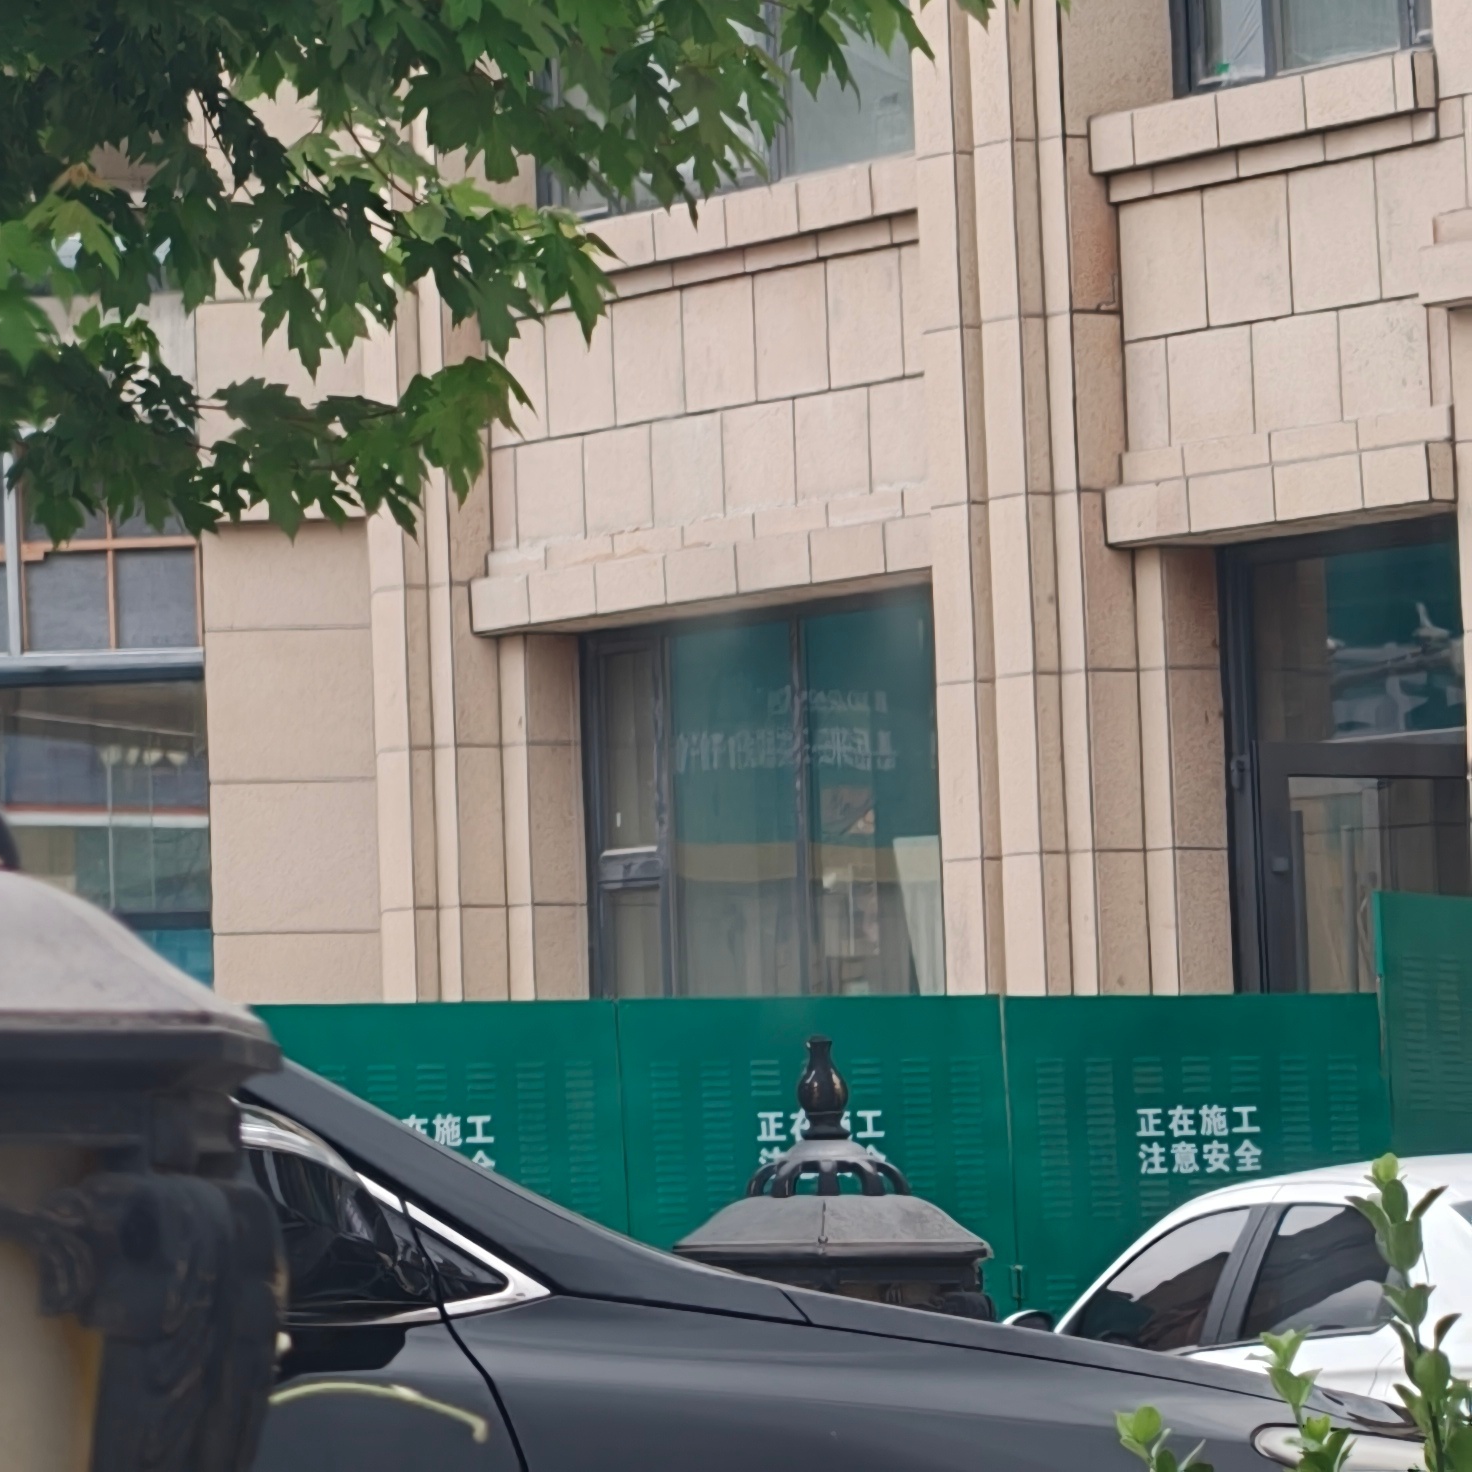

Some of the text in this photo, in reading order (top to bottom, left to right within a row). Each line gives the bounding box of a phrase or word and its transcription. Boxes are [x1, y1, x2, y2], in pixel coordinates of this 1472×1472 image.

[1136, 1104, 1262, 1138] 正在施工
[1138, 1139, 1263, 1175] 注意安全
